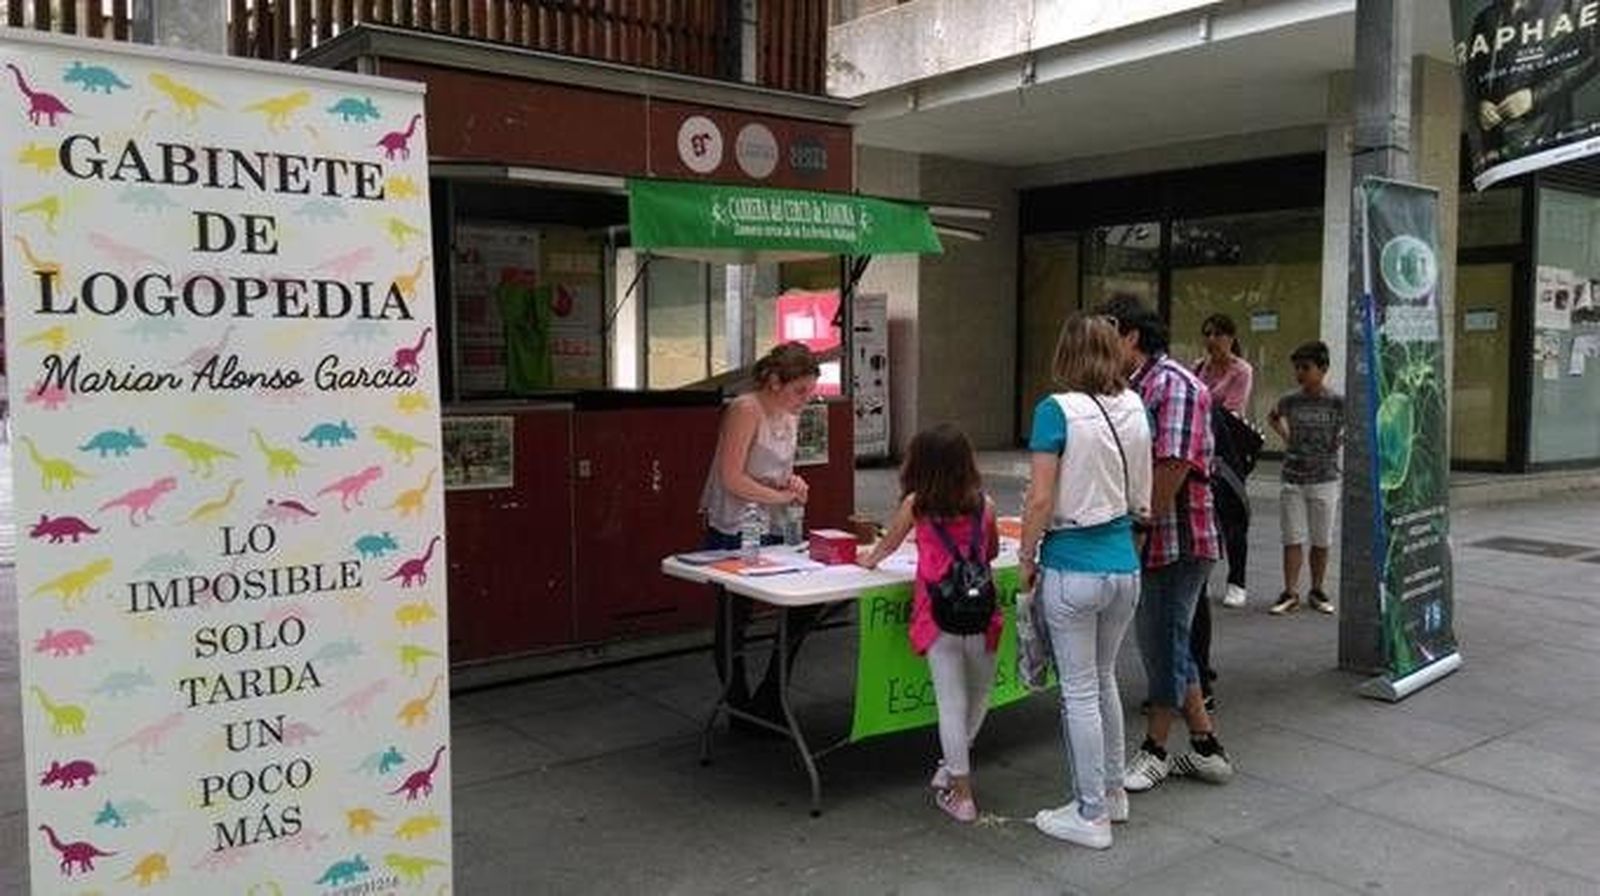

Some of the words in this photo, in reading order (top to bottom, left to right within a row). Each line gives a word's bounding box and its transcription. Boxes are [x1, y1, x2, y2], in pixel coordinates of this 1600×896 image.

[58, 134, 386, 201] GABINETE
[192, 211, 279, 255] DE
[34, 271, 414, 320] LOGOPEDIA
[38, 354, 183, 396] Marian
[191, 354, 304, 392] Alonso
[219, 523, 277, 557] LO
[126, 560, 363, 614] IMPOSIBLE
[194, 617, 306, 660] SOLO
[180, 661, 321, 708] TARDA
[225, 715, 288, 753] UN
[200, 759, 313, 808] POCO
[212, 802, 302, 853] MÁS
